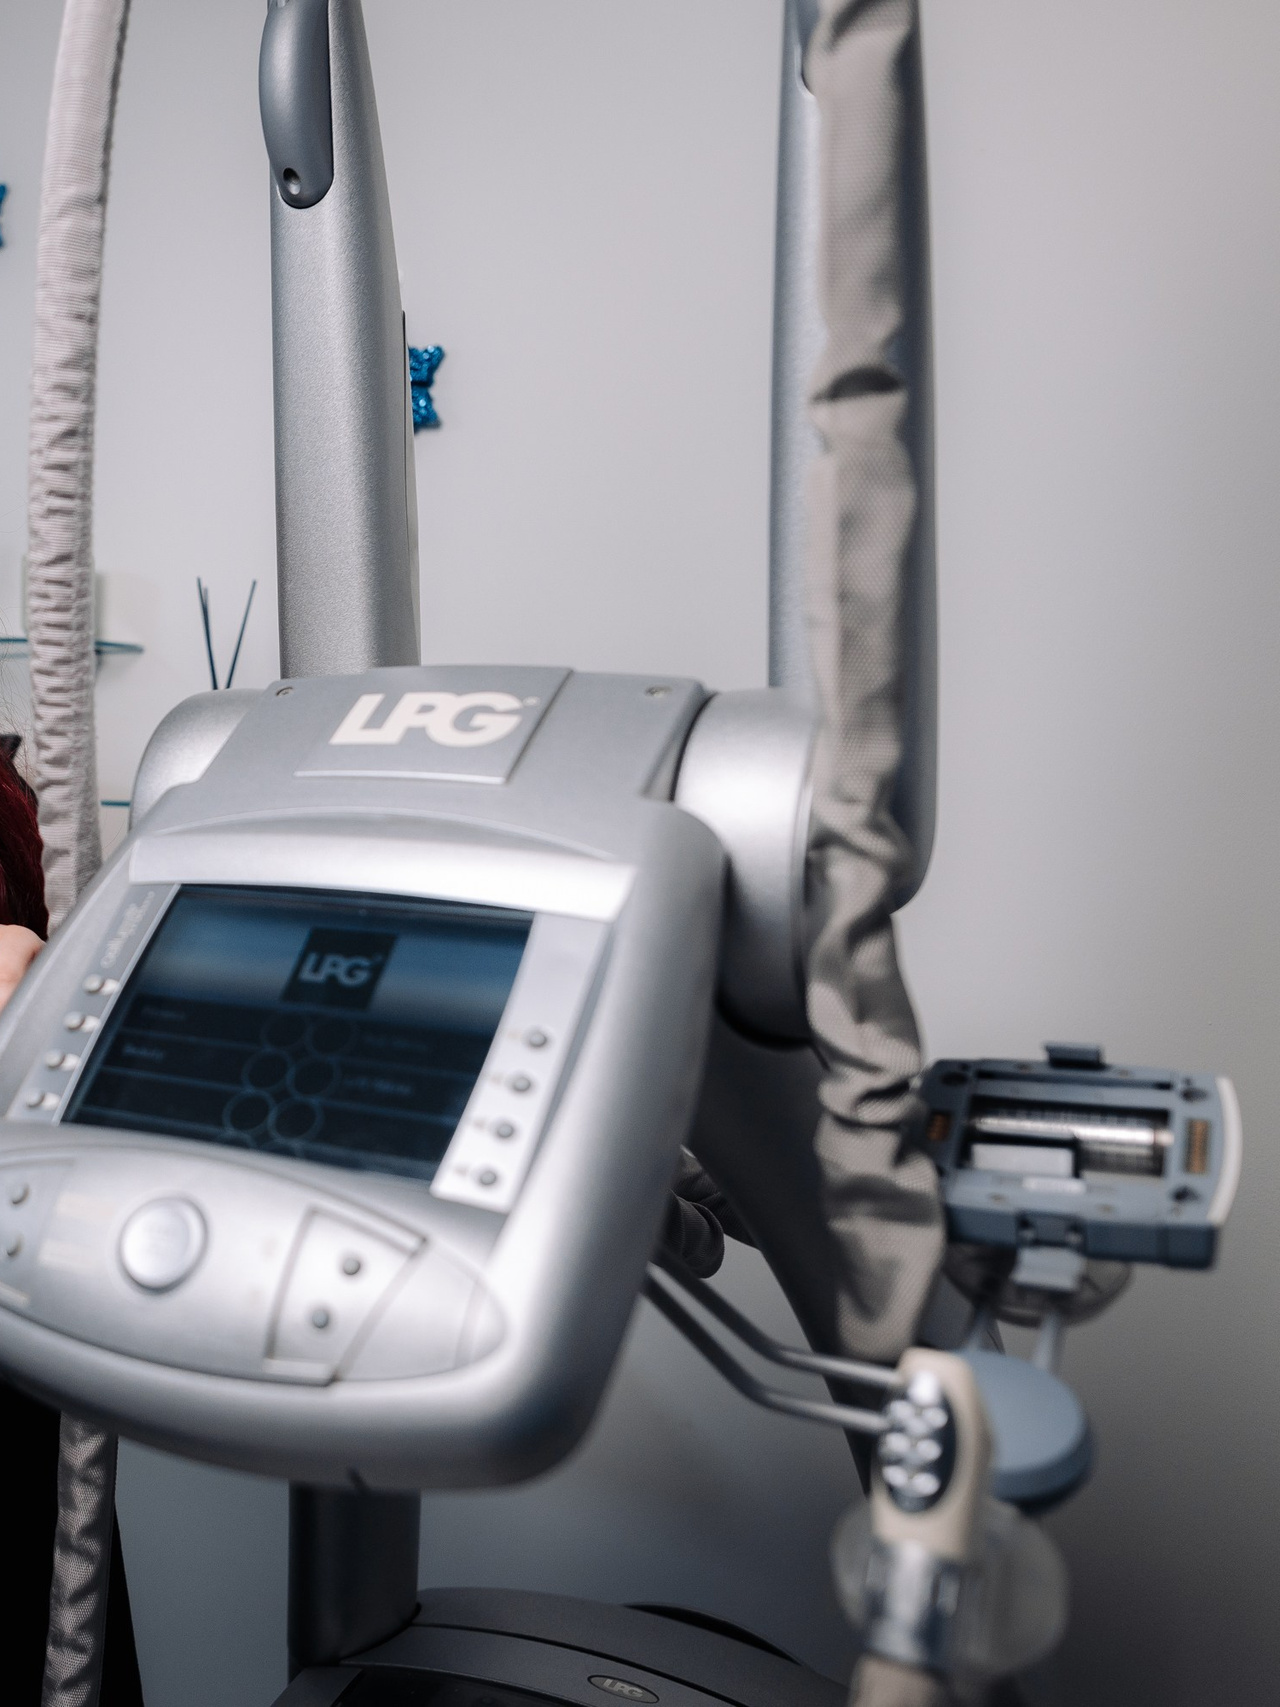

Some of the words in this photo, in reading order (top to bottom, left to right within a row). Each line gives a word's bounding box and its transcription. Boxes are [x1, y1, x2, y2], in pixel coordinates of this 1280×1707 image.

[328, 691, 526, 748] LPG
[297, 952, 372, 988] LPG
[602, 1678, 644, 1698] LPG
